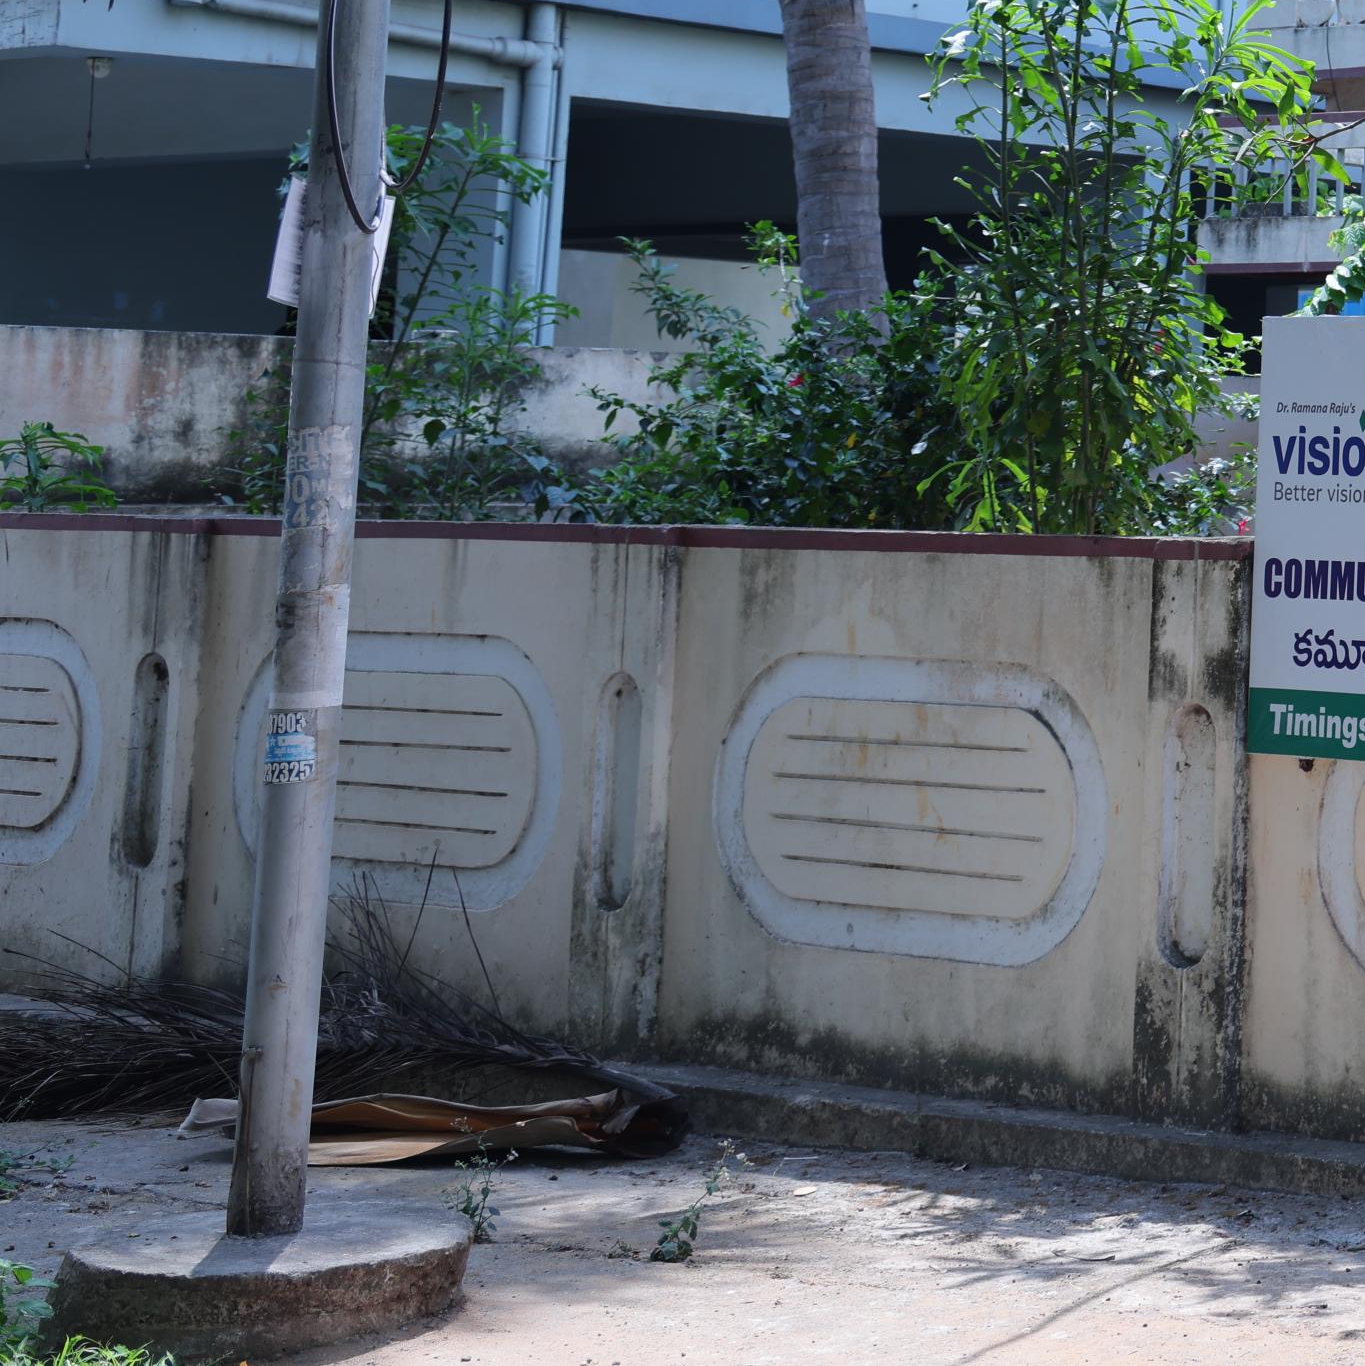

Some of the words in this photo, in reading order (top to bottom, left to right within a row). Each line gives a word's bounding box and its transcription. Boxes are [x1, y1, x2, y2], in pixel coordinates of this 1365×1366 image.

[1276, 401, 1290, 414] Dr.
[1291, 402, 1328, 414] Ramana
[1329, 403, 1356, 417] Raju's
[1274, 481, 1322, 502] Better
